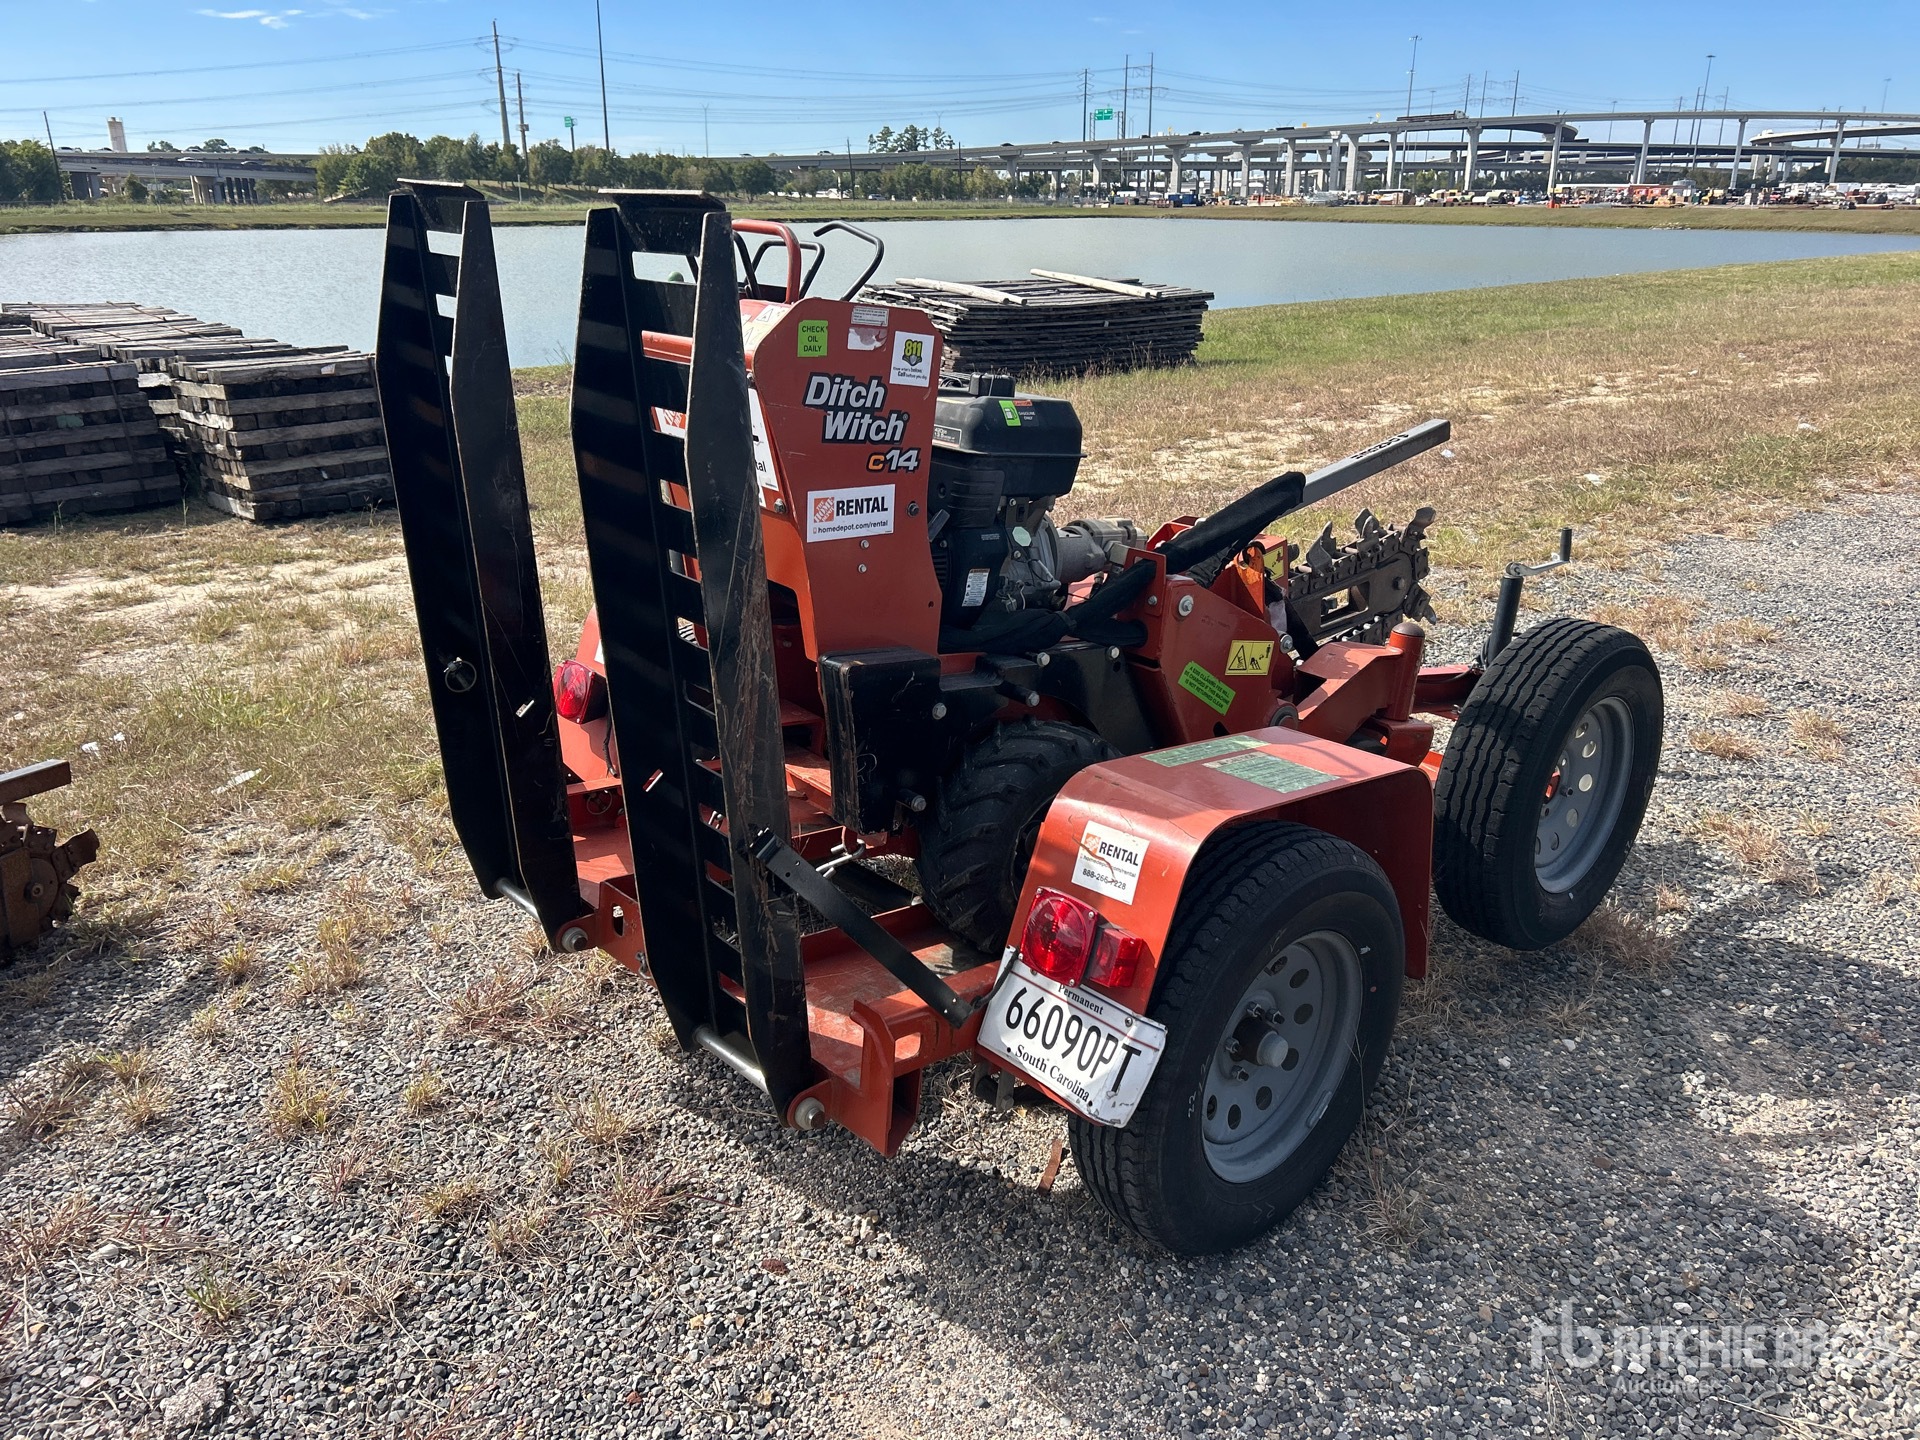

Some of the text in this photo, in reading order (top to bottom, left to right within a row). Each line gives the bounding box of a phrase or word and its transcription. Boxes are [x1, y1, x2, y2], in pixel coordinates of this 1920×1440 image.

[801, 325, 825, 333] CHECK
[807, 335, 819, 343] OIL
[803, 345, 823, 353] DAILY
[904, 339, 922, 357] 811
[804, 375, 886, 409] Ditch
[835, 496, 889, 517] RENTAL
[817, 520, 889, 534] homedepot.com/rental
[1098, 841, 1139, 867] RENTAL
[1058, 982, 1104, 1016] Permanent
[1005, 986, 1142, 1094] 66090PT
[1015, 1044, 1090, 1103] South Carolina
